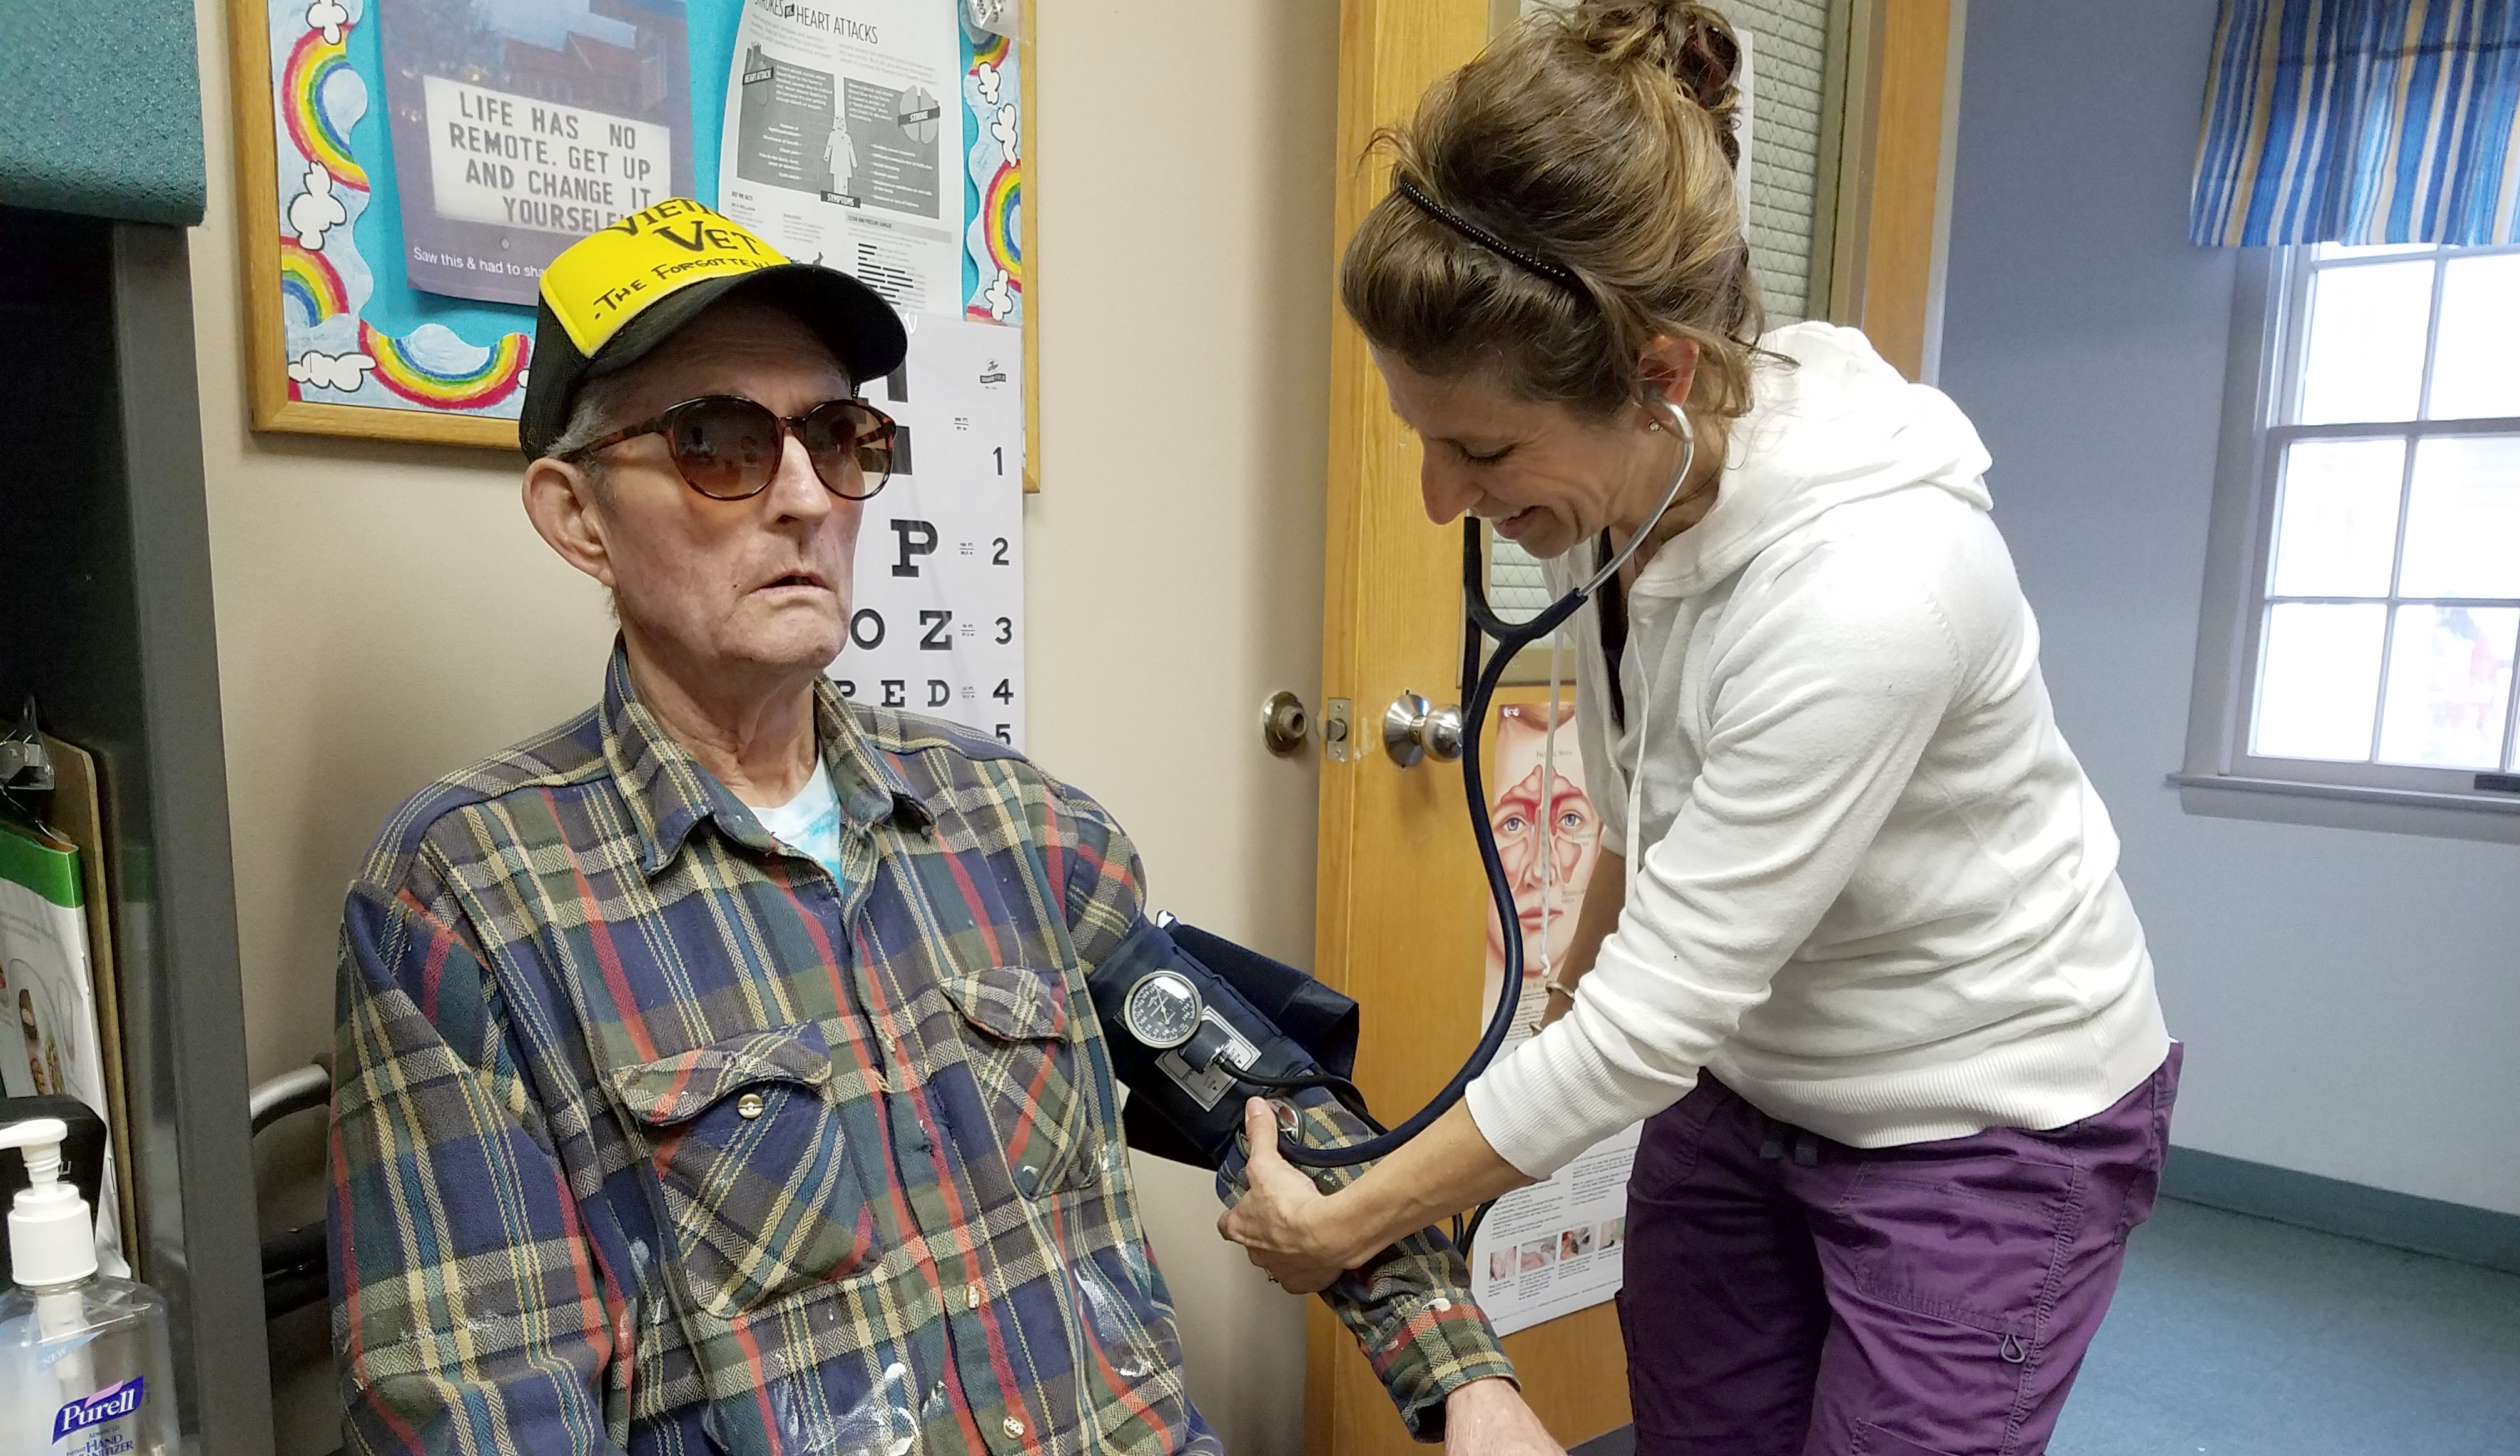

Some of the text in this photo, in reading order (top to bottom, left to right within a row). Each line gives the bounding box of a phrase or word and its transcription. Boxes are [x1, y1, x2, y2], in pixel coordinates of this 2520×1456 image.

[797, 5, 830, 32] HEART
[834, 17, 878, 44] ATTACKS
[460, 91, 636, 150] LIFE HAS NO
[450, 123, 651, 181] REMOTE. GET UP
[465, 159, 651, 209] AND CHANGE IT
[653, 221, 760, 255] VET
[414, 246, 437, 264] Saw
[441, 253, 464, 268] this
[467, 256, 477, 270] &
[479, 260, 504, 273] had
[506, 262, 521, 276] to
[594, 279, 647, 311] THE
[993, 447, 1003, 475] 1
[890, 519, 938, 577] P
[992, 537, 1009, 565] 2
[850, 608, 952, 650] O Z
[995, 617, 1012, 645] 3
[881, 680, 905, 707] E
[927, 679, 950, 707] D
[992, 678, 1014, 705] 4
[995, 724, 1011, 746] 5
[43, 1347, 68, 1367] NEW
[61, 1388, 135, 1432] Purell
[86, 1434, 123, 1452] HAND
